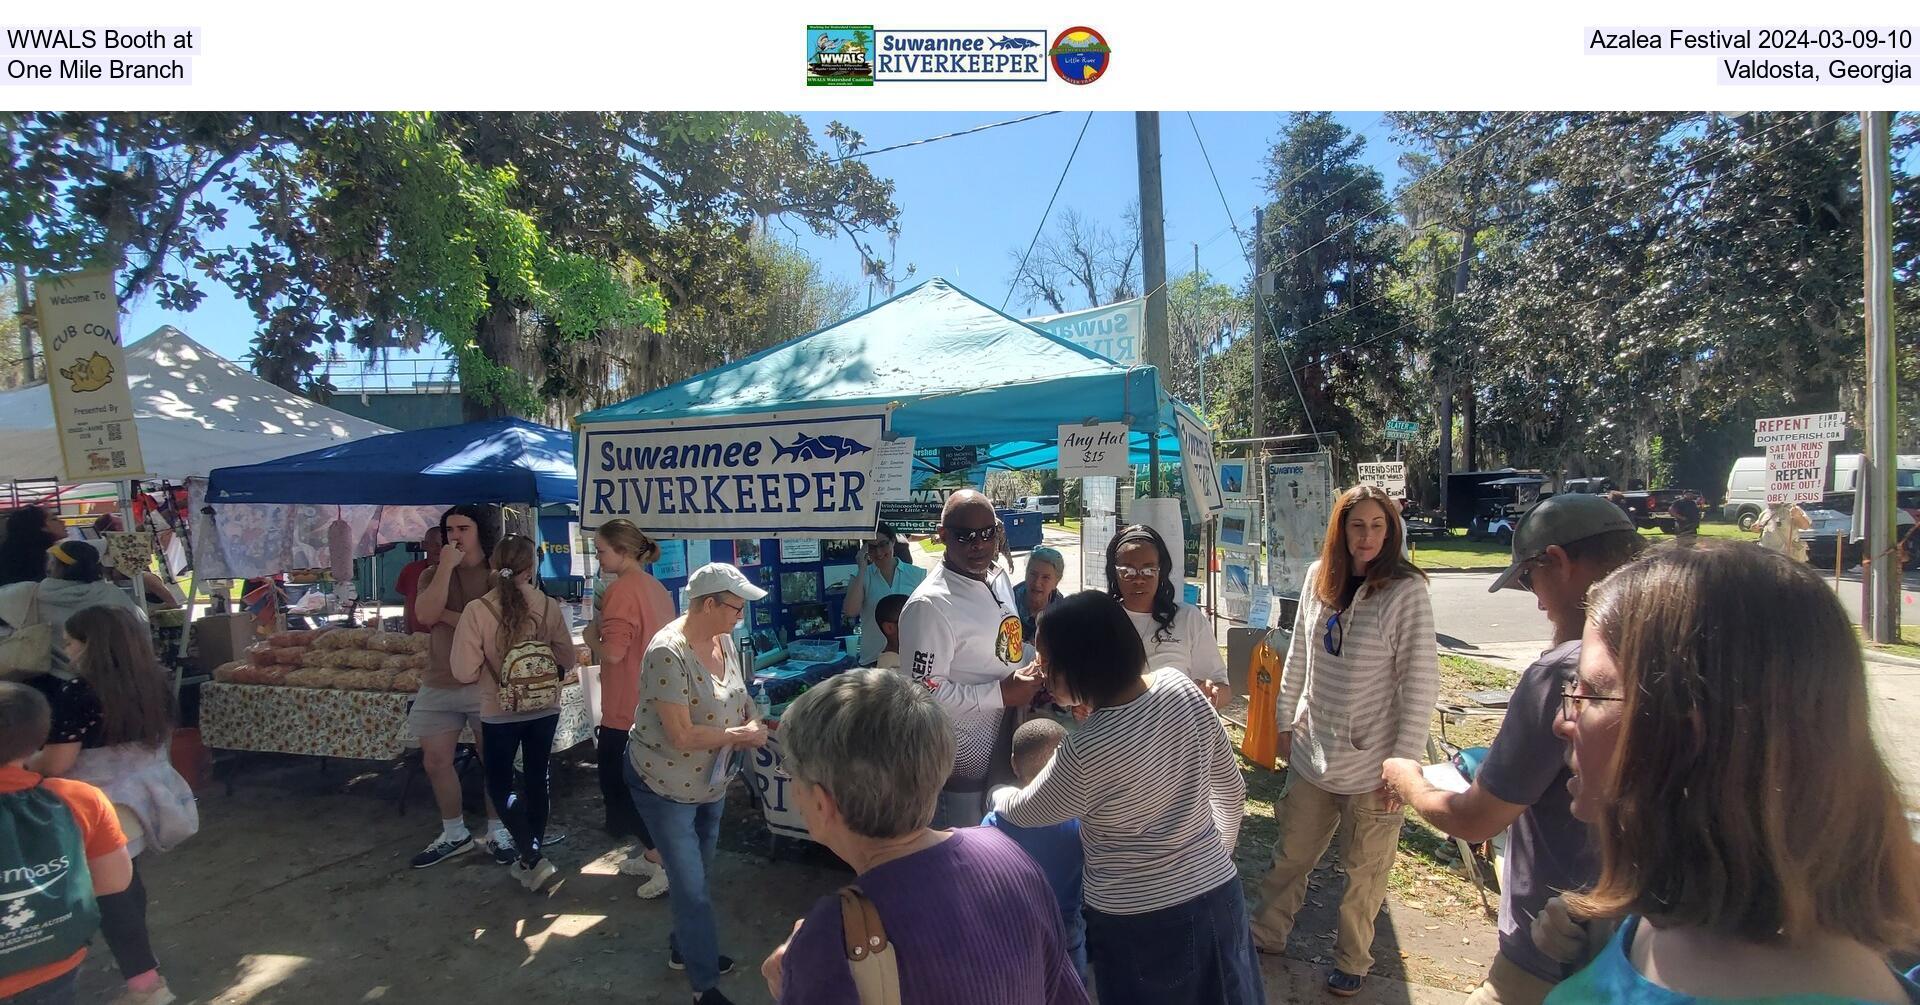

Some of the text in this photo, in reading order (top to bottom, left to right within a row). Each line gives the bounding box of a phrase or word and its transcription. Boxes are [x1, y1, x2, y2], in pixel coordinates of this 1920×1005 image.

[50, 291, 106, 305] Welcome To
[53, 323, 119, 351] CUB CON
[74, 403, 119, 415] Presented By
[1387, 422, 1410, 430] SLATER
[1758, 417, 1811, 432] REPENT
[1063, 431, 1125, 450] Any Hat
[1769, 442, 1824, 453] SATAN RUNS
[601, 441, 762, 471] Suwannee
[1082, 451, 1106, 463] $15
[1788, 450, 1820, 460] WORLD
[1270, 465, 1304, 475] Suwannee
[1359, 465, 1403, 474] FRIENDSHIP
[1781, 459, 1815, 469] CHURCH
[1775, 467, 1821, 481] REPENT
[589, 470, 866, 515] RIVERKEEPER
[1770, 482, 1796, 491] COME
[1767, 492, 1819, 502] OBEY JESUS
[1005, 620, 1020, 634] Bass
[1, 855, 70, 883] mpass
